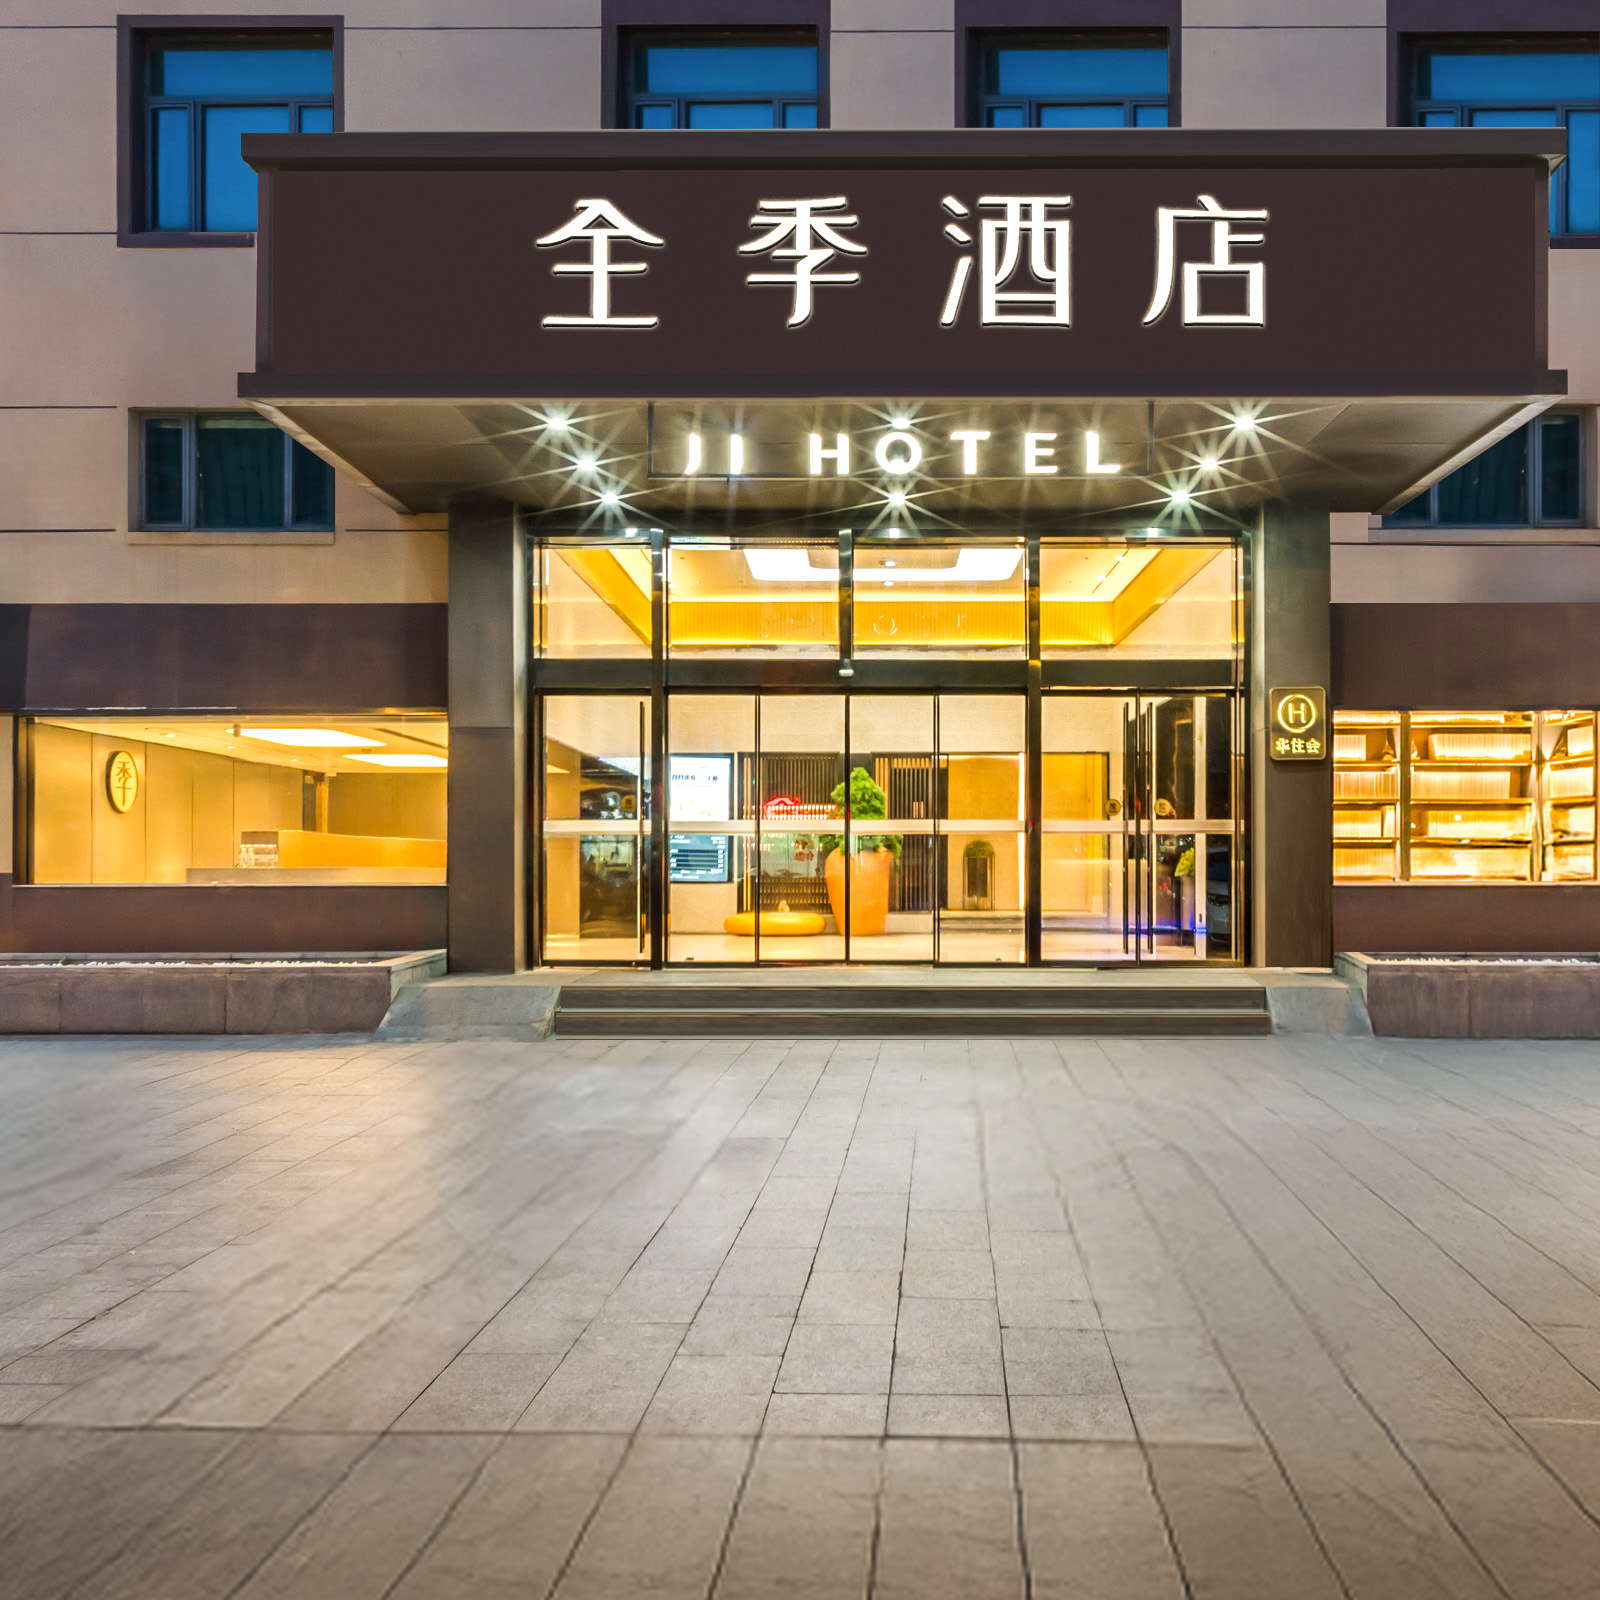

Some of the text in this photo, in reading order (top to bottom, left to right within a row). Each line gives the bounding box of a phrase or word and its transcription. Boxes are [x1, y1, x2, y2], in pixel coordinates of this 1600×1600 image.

[535, 196, 1268, 328] 全季酒店
[684, 431, 1121, 475] JI HOTEL
[1276, 737, 1320, 755] 华住会
[115, 761, 133, 806] 季
